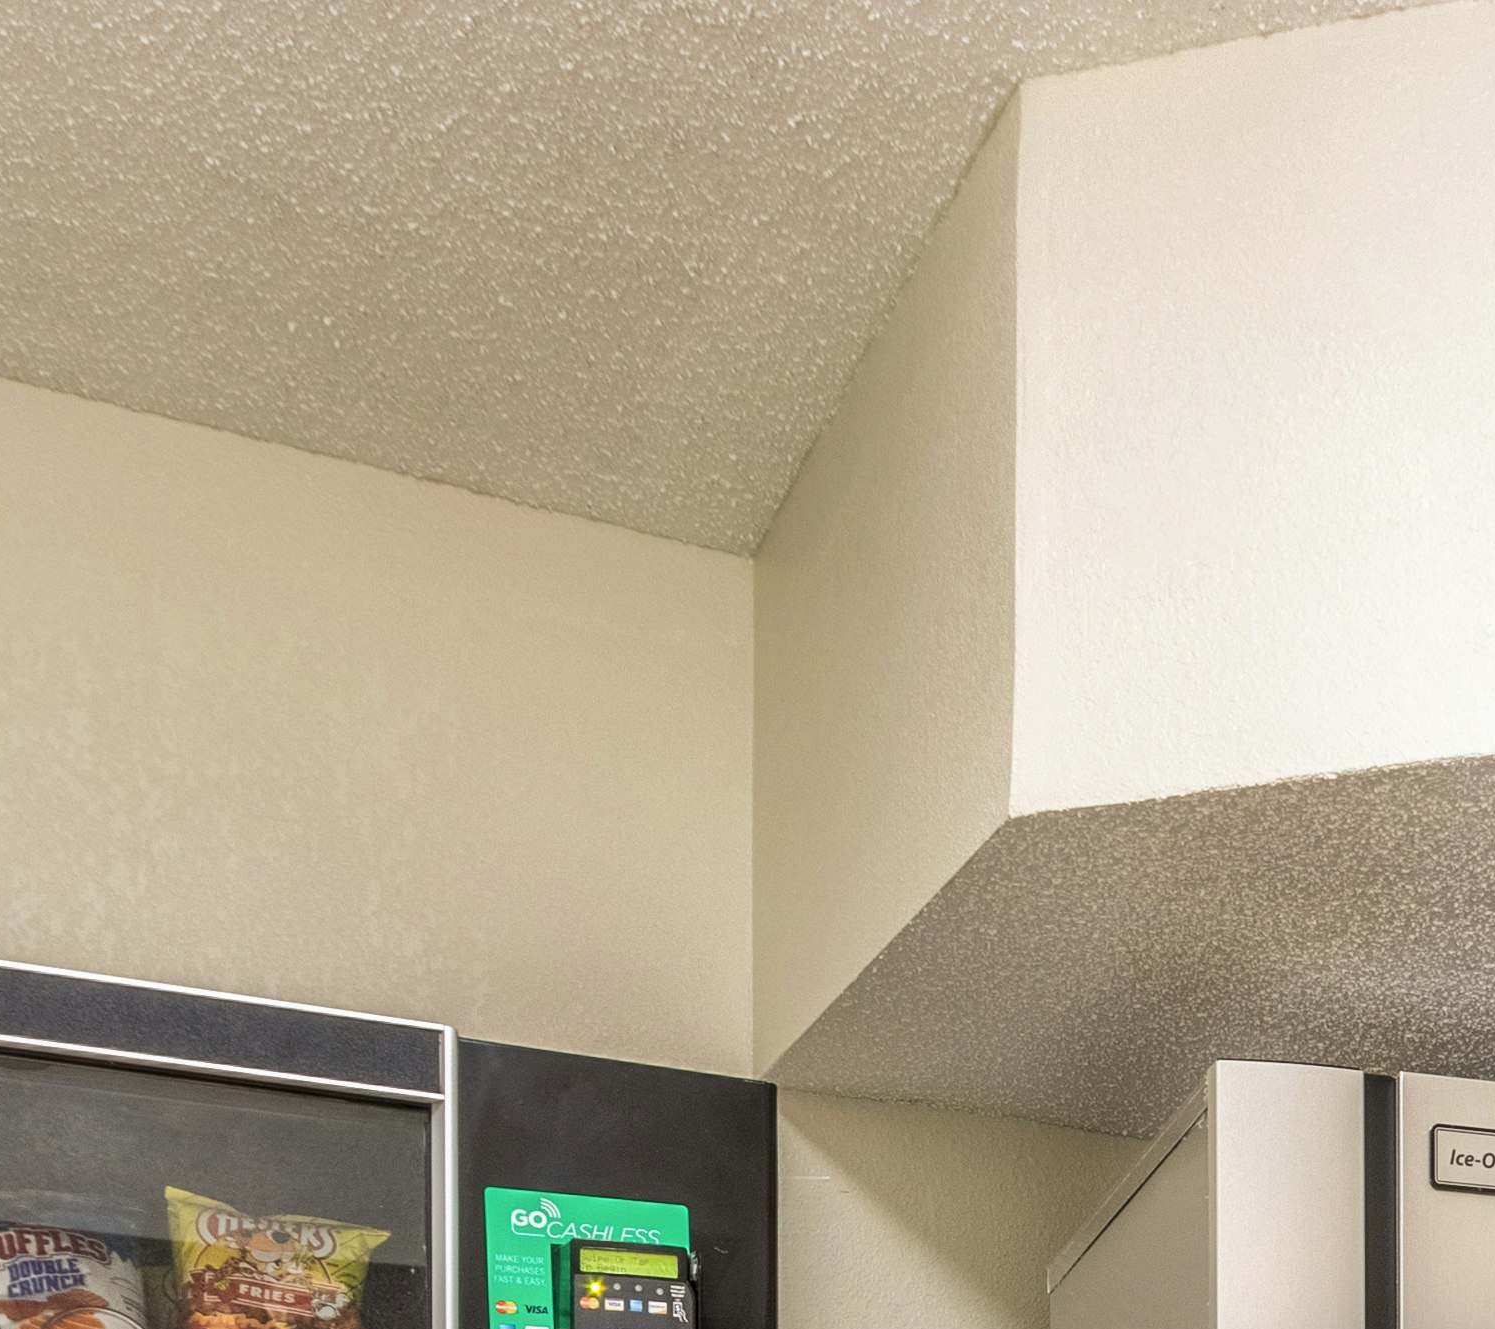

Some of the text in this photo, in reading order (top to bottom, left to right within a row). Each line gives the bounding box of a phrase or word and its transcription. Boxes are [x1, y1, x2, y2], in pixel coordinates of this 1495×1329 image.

[511, 1209, 547, 1228] GO
[496, 1254, 543, 1265] MAKE YOUR
[7, 1258, 80, 1282] DOUBLE
[496, 1265, 545, 1276] PURCHASES
[8, 1273, 86, 1298] CRUNCH
[494, 1276, 515, 1284] FAST
[238, 1283, 296, 1304] FRIES
[525, 1304, 548, 1314] VISA
